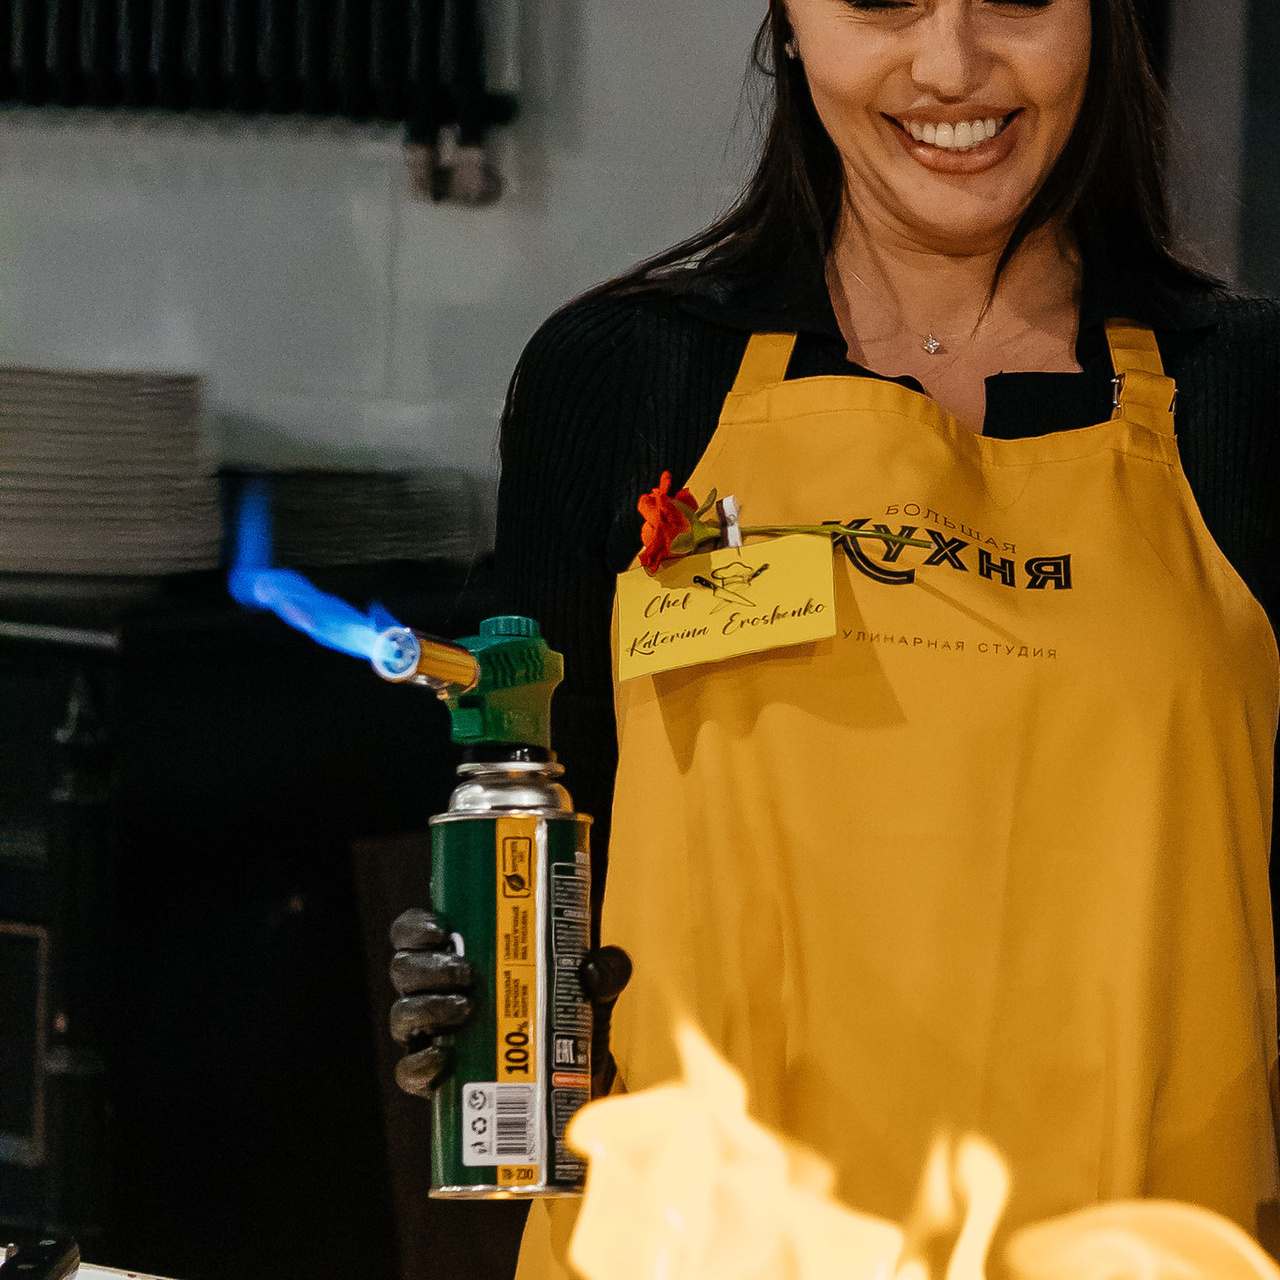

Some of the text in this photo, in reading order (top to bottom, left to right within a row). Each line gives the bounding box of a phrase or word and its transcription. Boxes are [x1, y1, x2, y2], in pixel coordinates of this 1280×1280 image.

[885, 503, 1017, 555] БОЛЬШАЯ
[821, 518, 1073, 590] КУХНЯ
[643, 592, 690, 619] Chef
[625, 626, 710, 657] Katerina
[841, 630, 1059, 660] УЛИНАРНАЯ СТУДИЯ
